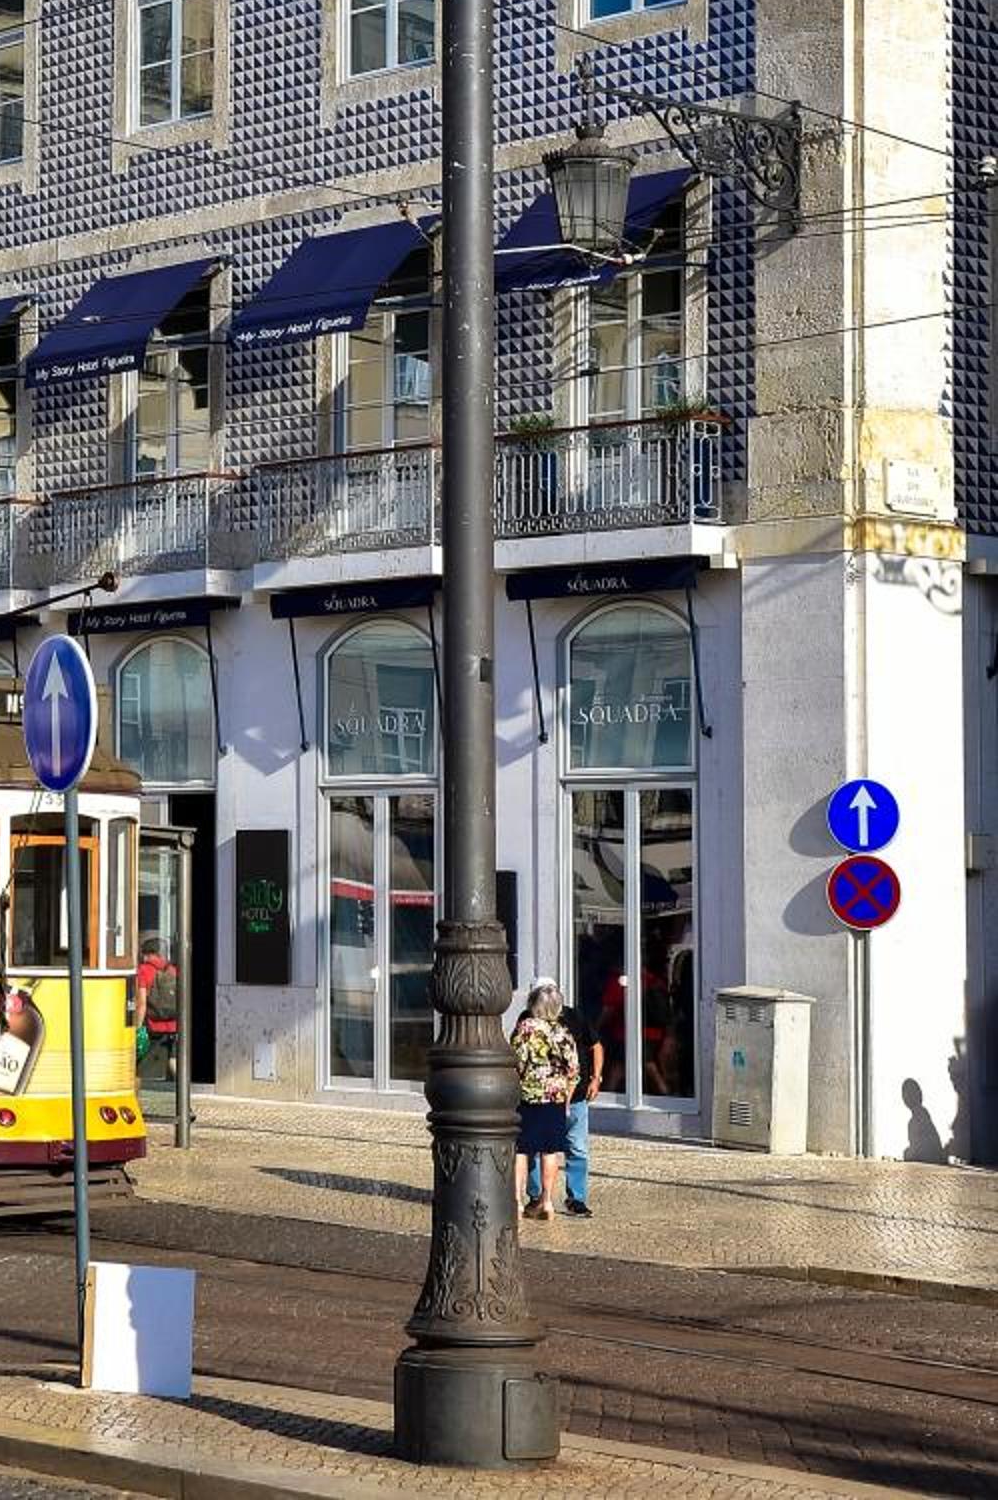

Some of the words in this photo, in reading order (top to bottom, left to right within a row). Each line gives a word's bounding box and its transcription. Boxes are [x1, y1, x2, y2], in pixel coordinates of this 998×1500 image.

[236, 331, 257, 342] My
[258, 328, 285, 339] Story
[287, 320, 313, 334] Hotel
[315, 315, 352, 331] Figueira
[35, 368, 50, 381] My
[51, 365, 74, 377] Story
[77, 359, 99, 372] Hotel
[102, 355, 135, 370] Figueira
[86, 616, 101, 628] My
[104, 615, 125, 627] Story
[129, 612, 151, 624] Hotel
[154, 609, 187, 624] Figueira
[573, 703, 683, 726] SQUADRA
